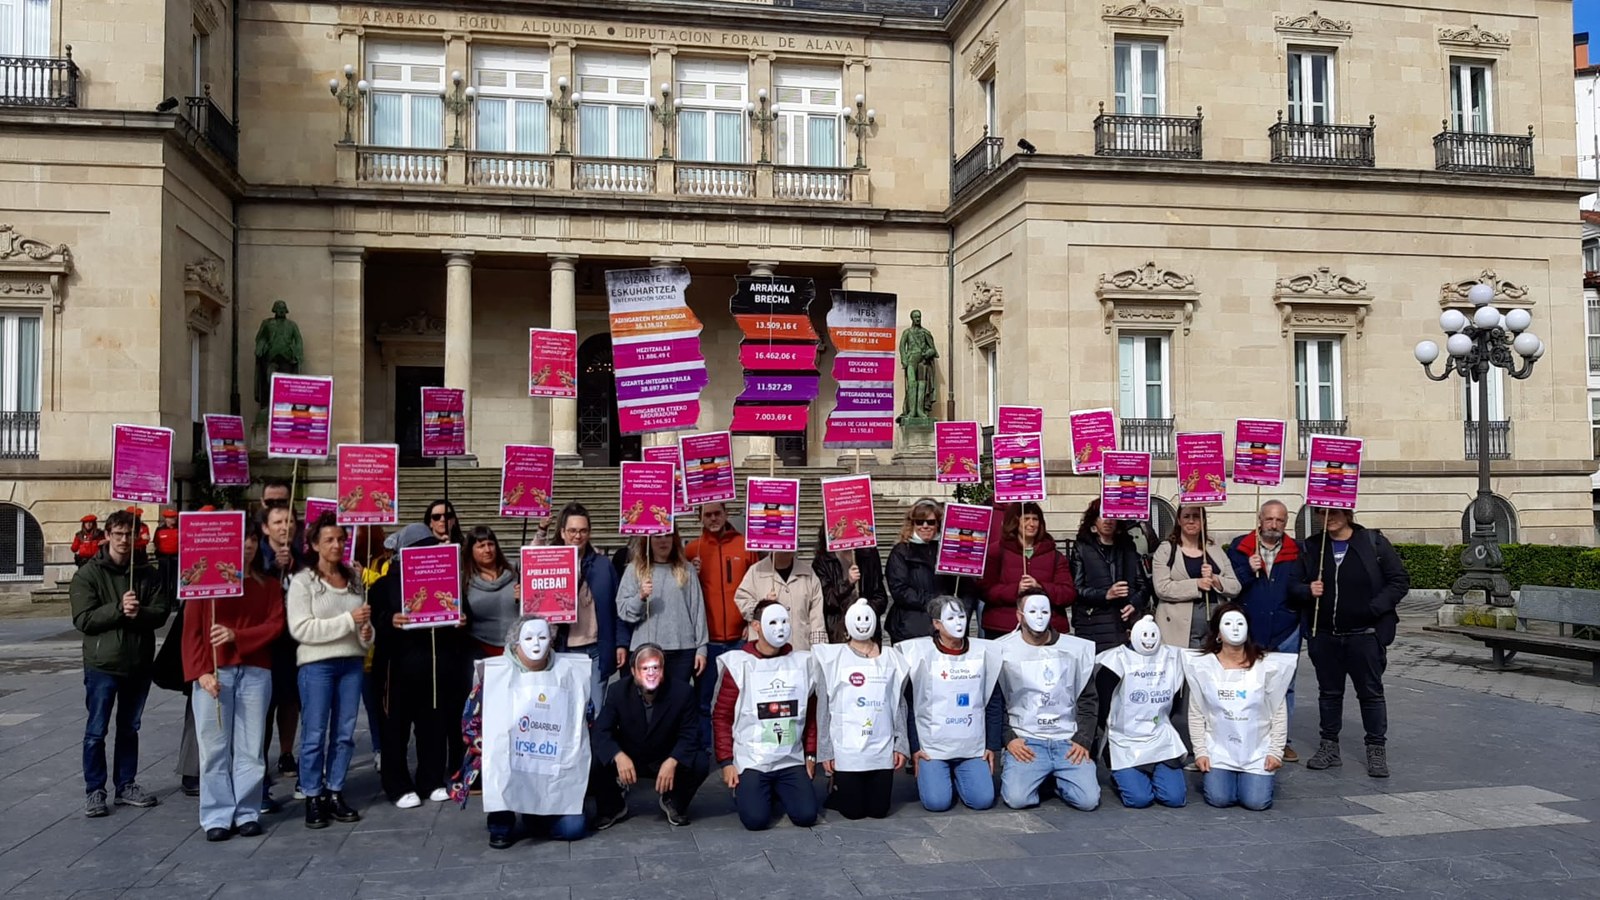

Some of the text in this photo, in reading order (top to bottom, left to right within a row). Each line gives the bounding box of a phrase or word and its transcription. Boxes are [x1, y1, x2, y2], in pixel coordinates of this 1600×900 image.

[362, 10, 854, 51] ARABAKO FORU ALDUNDIA DIPUTACION FORAL DE ALAVA
[623, 275, 662, 284] GIZARTE
[612, 285, 677, 297] ESKUHARTZEA
[750, 283, 795, 293] ARRAKALA
[754, 295, 790, 304] BRECHA
[615, 313, 686, 323] ADINGABEEN PSIKOLOGOA
[756, 322, 791, 330] 13.509,16
[532, 577, 567, 590] GREBA!!
[1150, 689, 1171, 697] GRUPO
[530, 721, 561, 732] OBARBURU
[515, 737, 558, 755] irse.ebi
